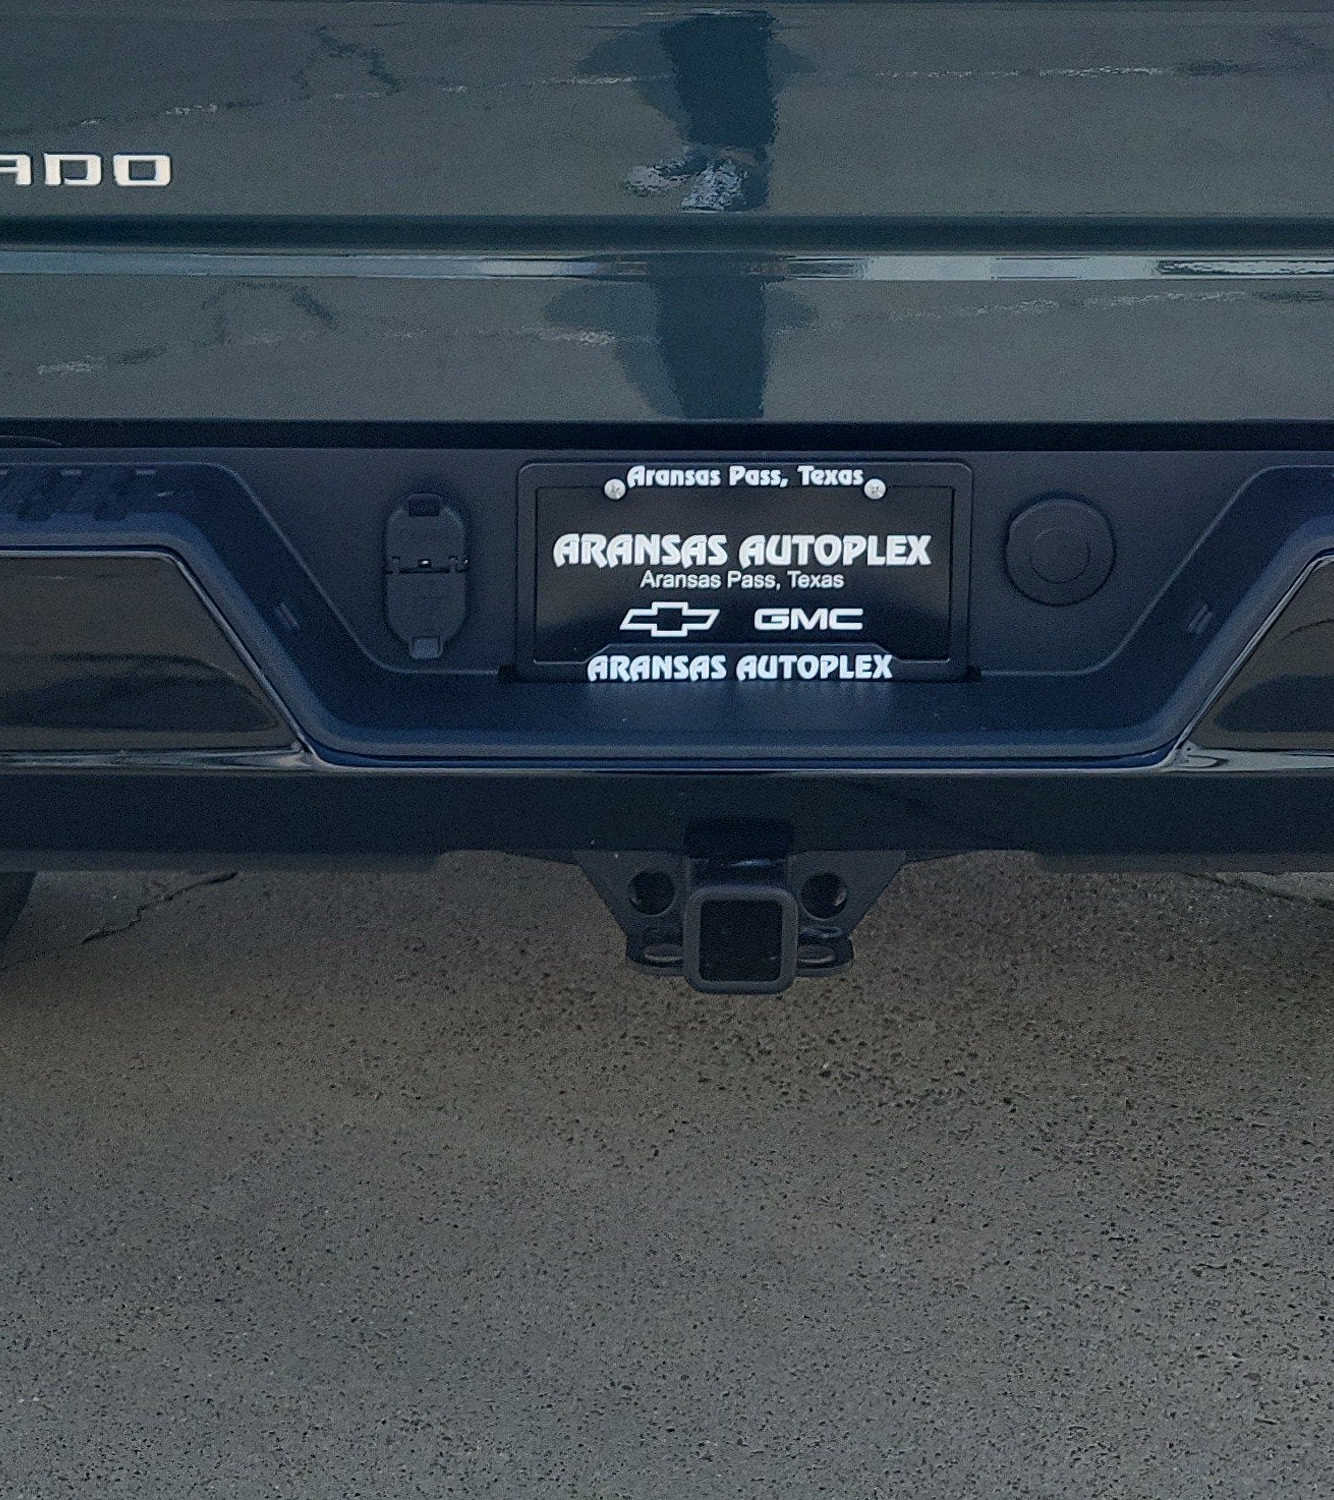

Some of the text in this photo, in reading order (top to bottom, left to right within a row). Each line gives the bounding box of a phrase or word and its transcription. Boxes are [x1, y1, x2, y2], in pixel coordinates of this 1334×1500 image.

[627, 465, 864, 489] Aransas Pass, Texas
[552, 533, 933, 569] ARANSAS AUTOPLEX
[640, 569, 845, 591] Aransas Pass, Texas
[753, 608, 864, 631] GMC
[587, 654, 893, 683] ARANSAS AUTOPLEX
